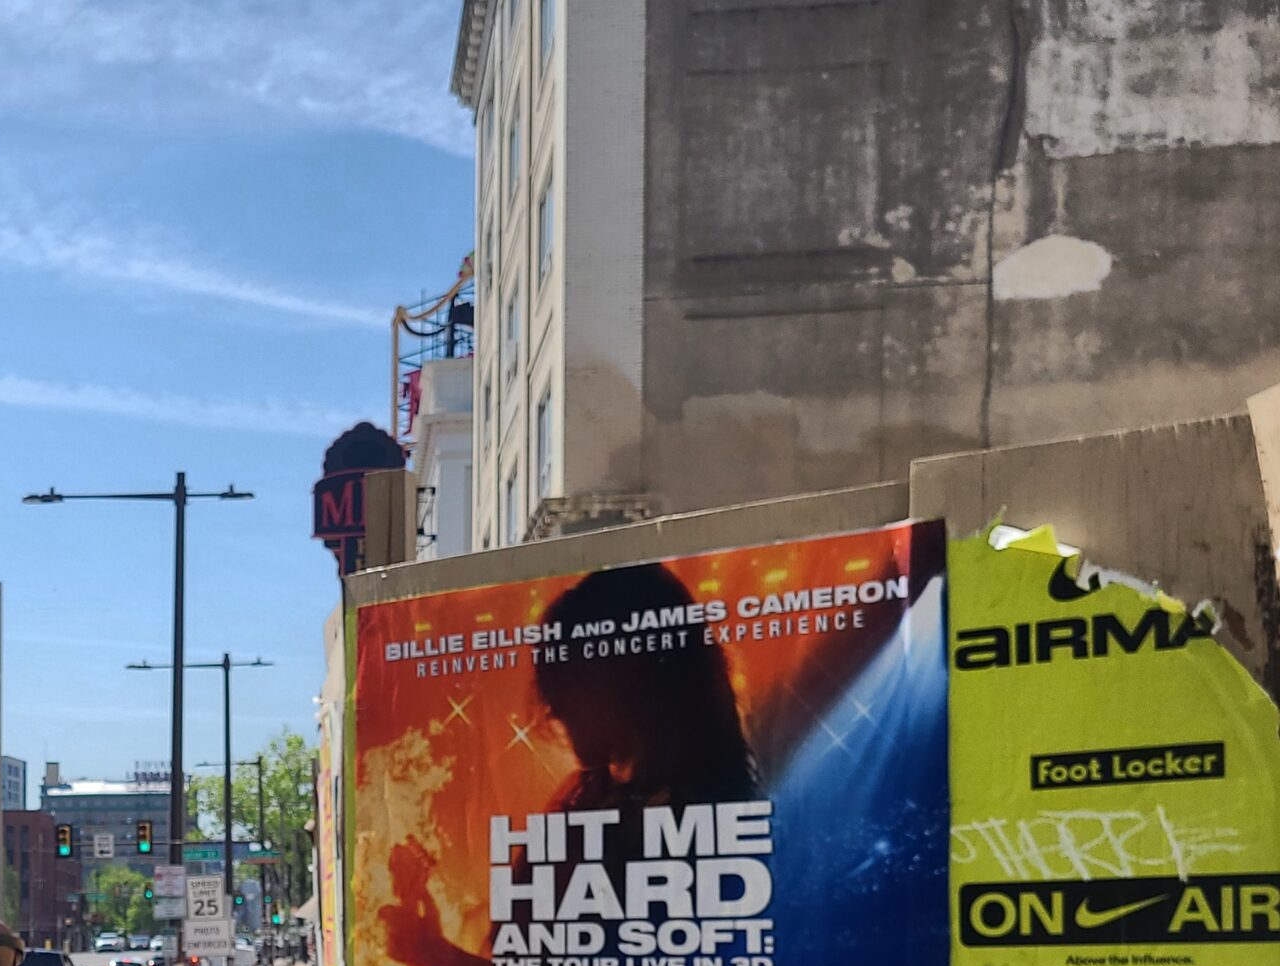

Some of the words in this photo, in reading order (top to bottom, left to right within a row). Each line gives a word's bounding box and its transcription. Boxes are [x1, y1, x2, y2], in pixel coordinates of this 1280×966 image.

[385, 634, 464, 662] BILLIE
[472, 622, 562, 650] EILISH
[571, 620, 615, 639] AND
[621, 600, 727, 633] JAMES
[737, 575, 909, 619] CAMERON
[417, 652, 518, 678] REINVENT
[532, 645, 569, 665] THE
[583, 632, 688, 659] CONCERT
[703, 609, 865, 646] EXPERIENCE
[1037, 759, 1102, 785] Foot
[1112, 751, 1217, 779] Locker
[489, 809, 620, 864] HIT
[643, 800, 773, 858] ME
[190, 880, 219, 888] SPEED
[489, 857, 773, 922] HARD
[194, 900, 218, 917] 25
[969, 891, 1064, 938] ON
[1168, 884, 1280, 933] AIR
[491, 922, 606, 956] AND
[617, 918, 774, 957] SOFT:
[1066, 955, 1106, 966] Above
[1108, 955, 1129, 965] the
[1131, 954, 1194, 965] Influence.
